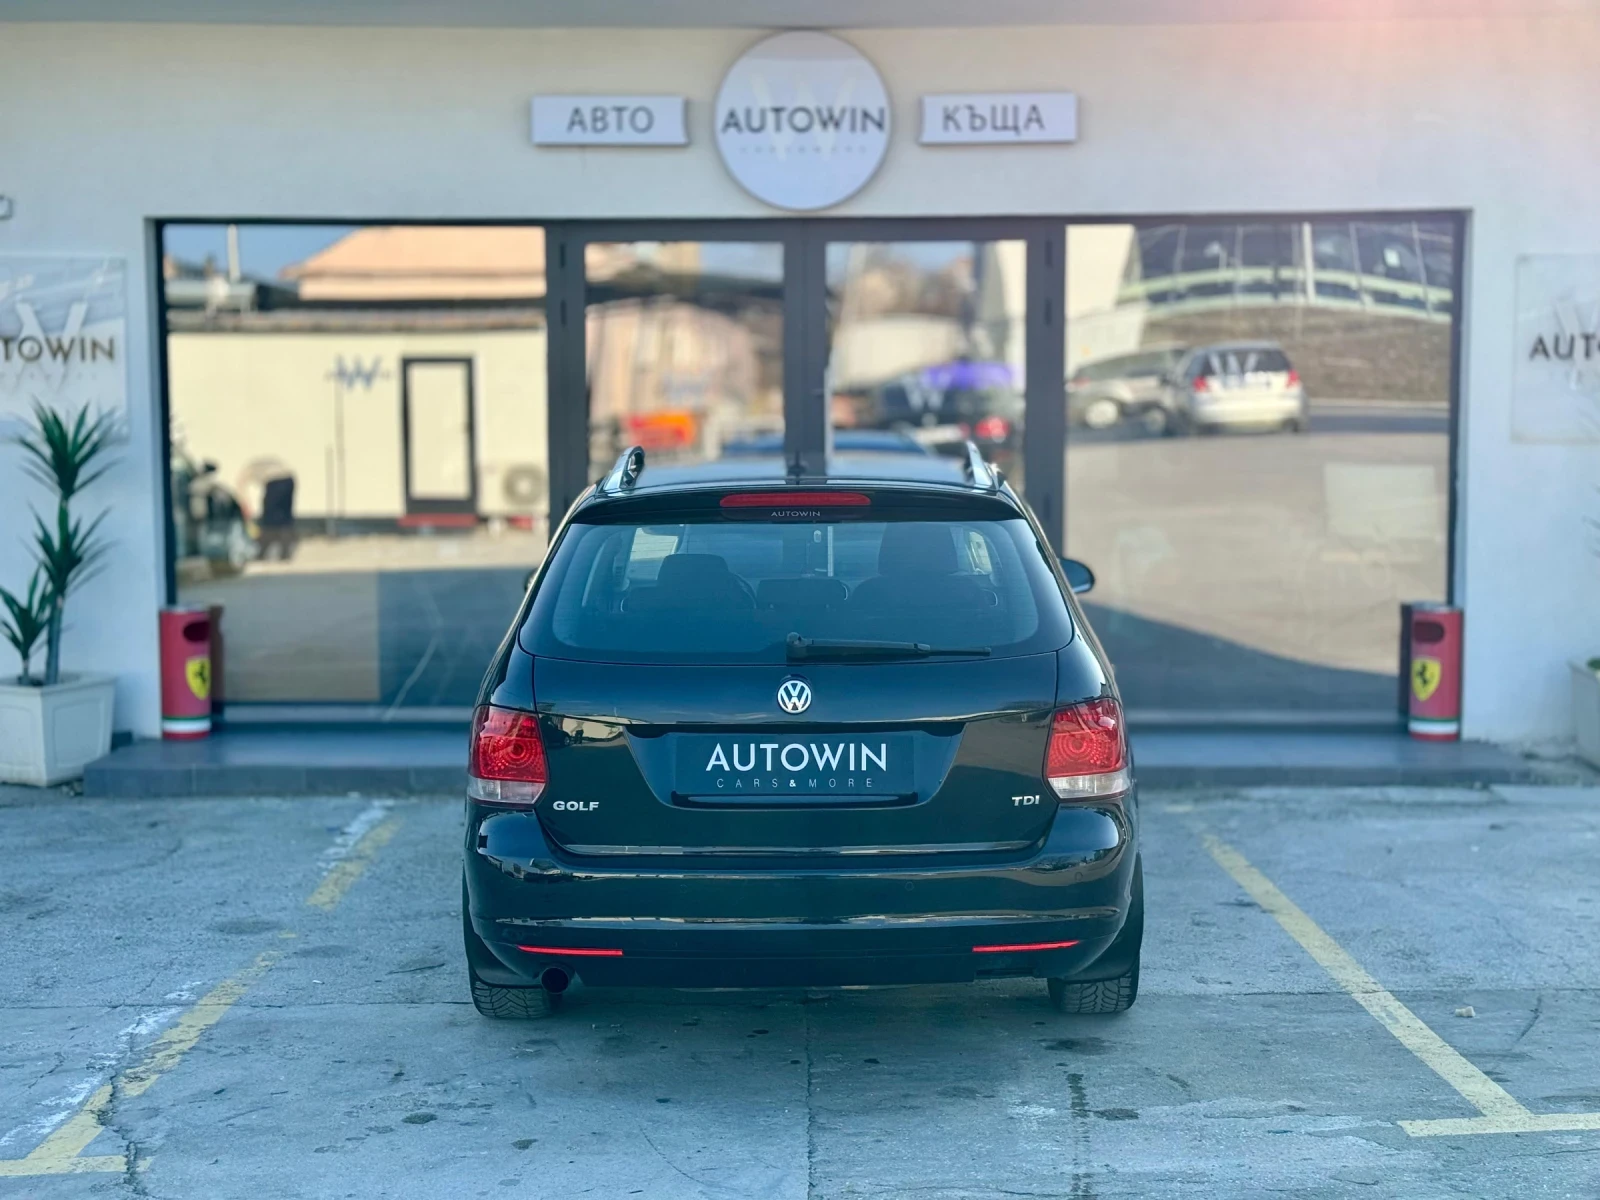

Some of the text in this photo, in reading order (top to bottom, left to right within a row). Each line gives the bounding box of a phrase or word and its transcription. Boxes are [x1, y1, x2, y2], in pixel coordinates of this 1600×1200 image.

[566, 106, 654, 134] АВТО
[720, 105, 886, 134] AUTOWIN
[941, 103, 1046, 136] КЪЩА
[1528, 332, 1600, 361] AUT
[705, 742, 887, 772] AUTOWIN
[552, 800, 600, 811] GOLF
[1011, 794, 1040, 806] TDI
